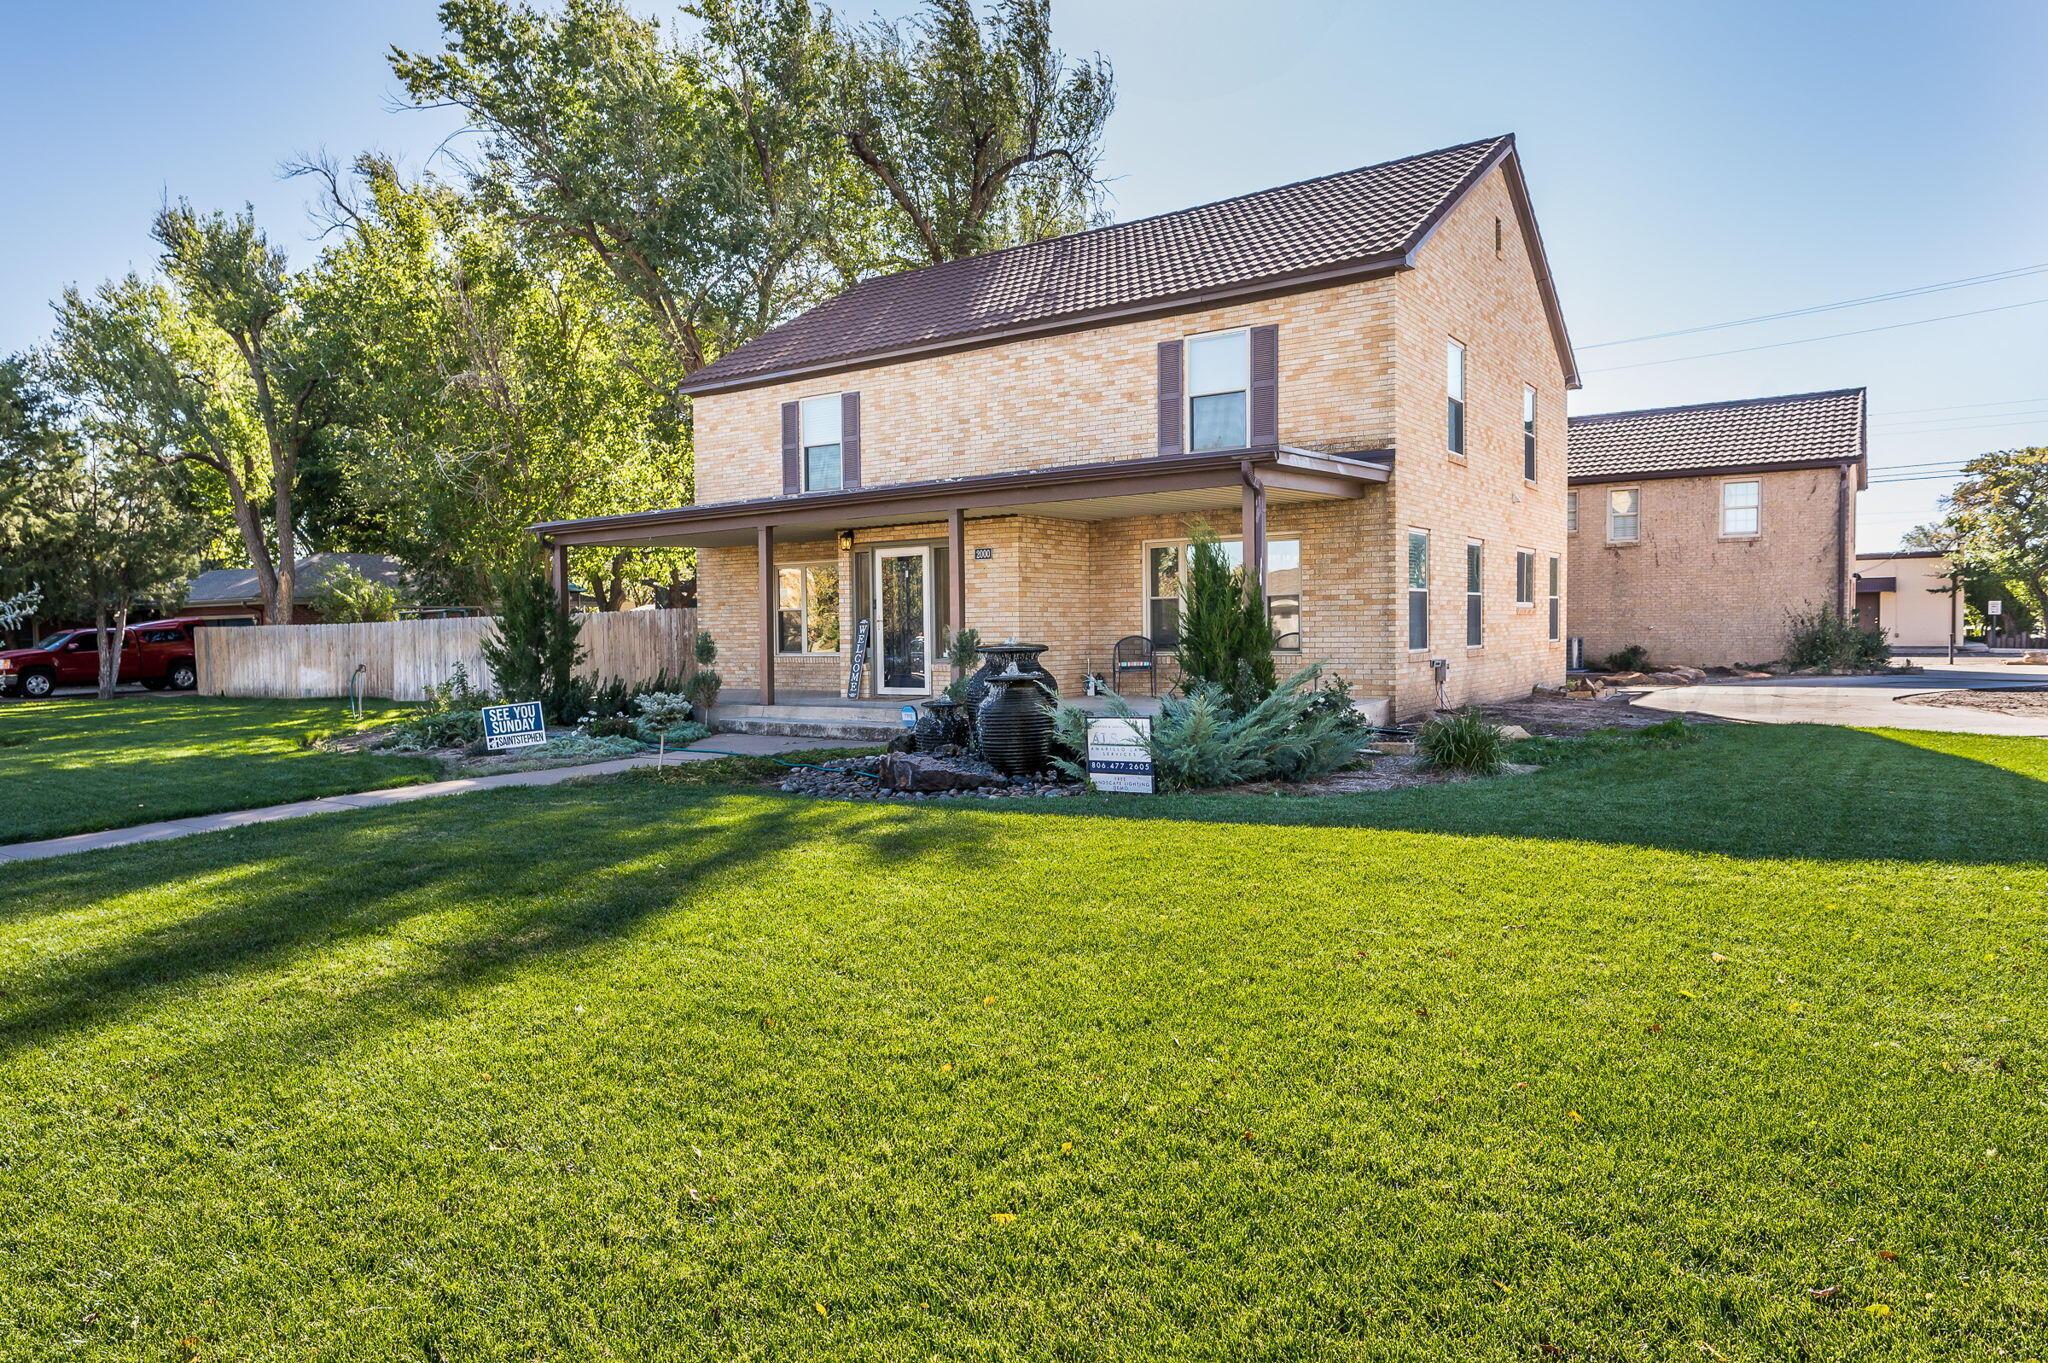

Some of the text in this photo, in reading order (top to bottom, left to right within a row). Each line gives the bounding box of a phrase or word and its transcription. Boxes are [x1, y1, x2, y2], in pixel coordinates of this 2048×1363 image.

[850, 625, 867, 692] WELCOME
[489, 705, 536, 722] SEE YOU
[492, 717, 535, 734] SUNDAY
[1091, 761, 1150, 771] 806.477.2605
